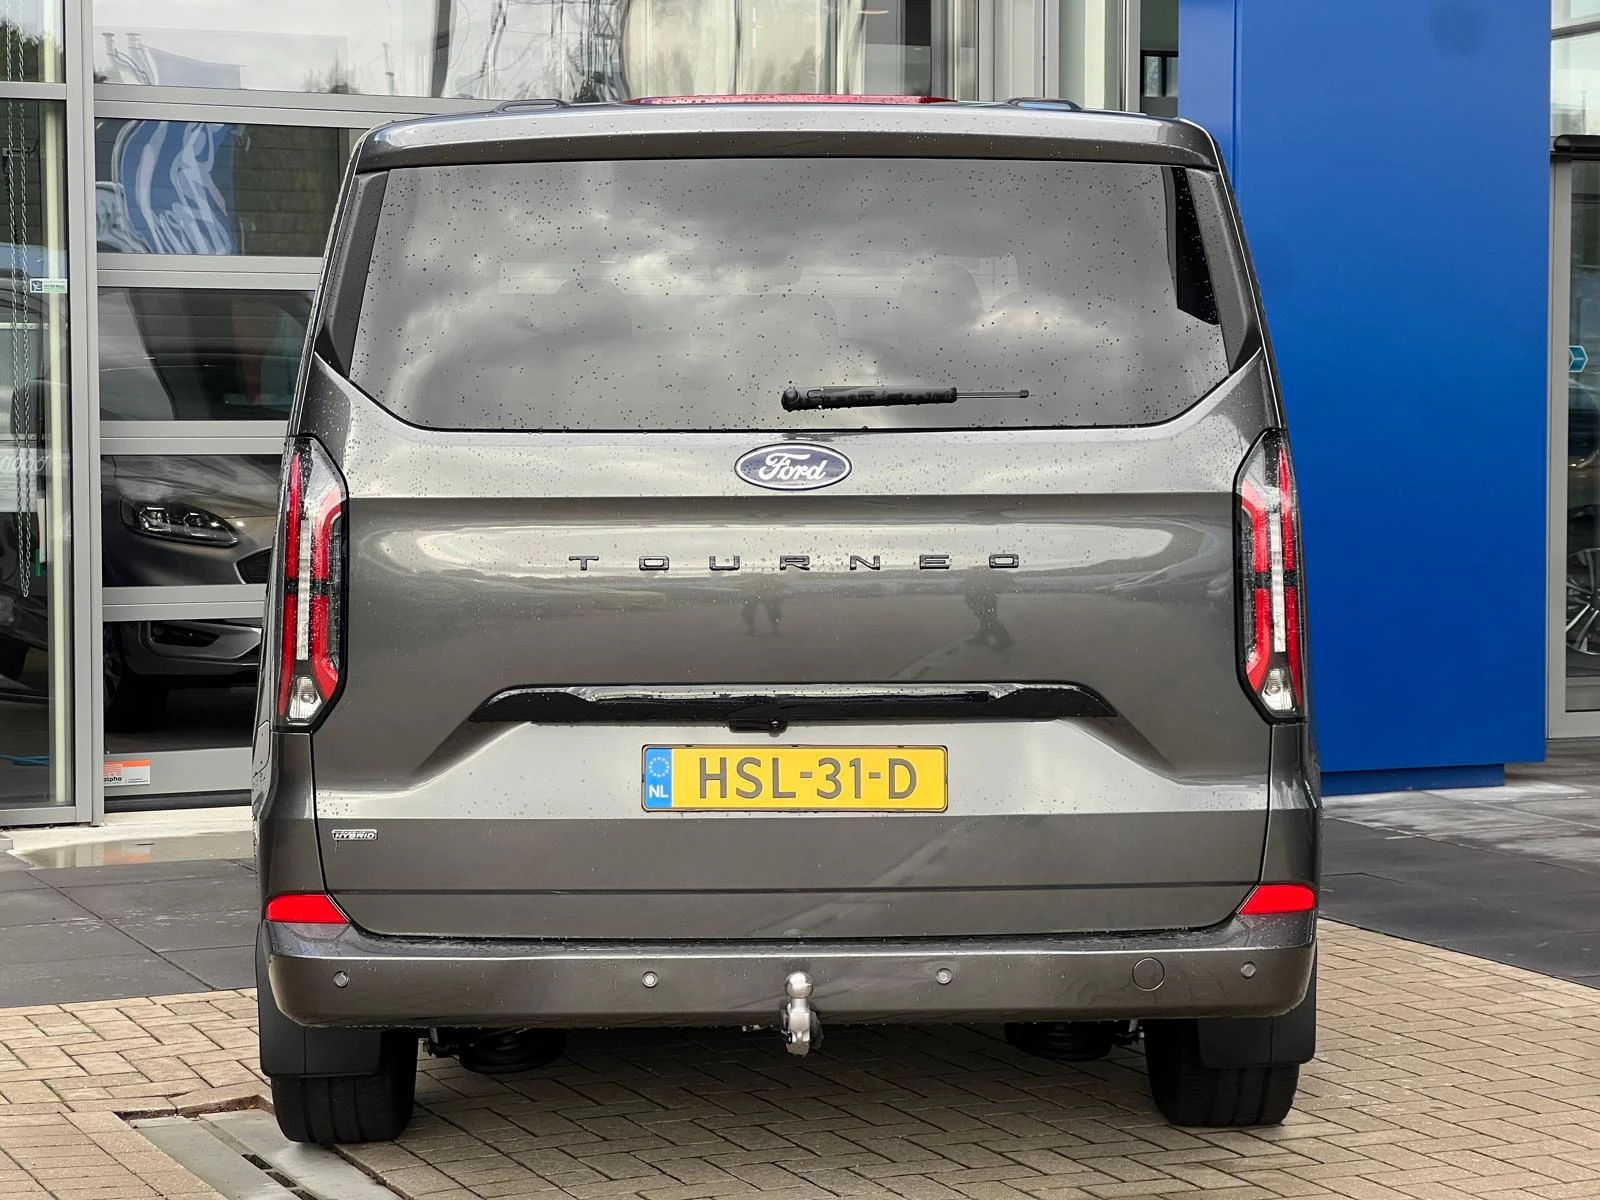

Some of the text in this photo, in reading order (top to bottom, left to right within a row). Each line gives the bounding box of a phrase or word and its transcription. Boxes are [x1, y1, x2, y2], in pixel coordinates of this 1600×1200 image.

[758, 452, 828, 480] Ford
[568, 554, 1019, 571] TOURNEO
[699, 757, 917, 799] HSL-31-D
[648, 784, 669, 798] NL
[333, 830, 376, 840] HYBRID
